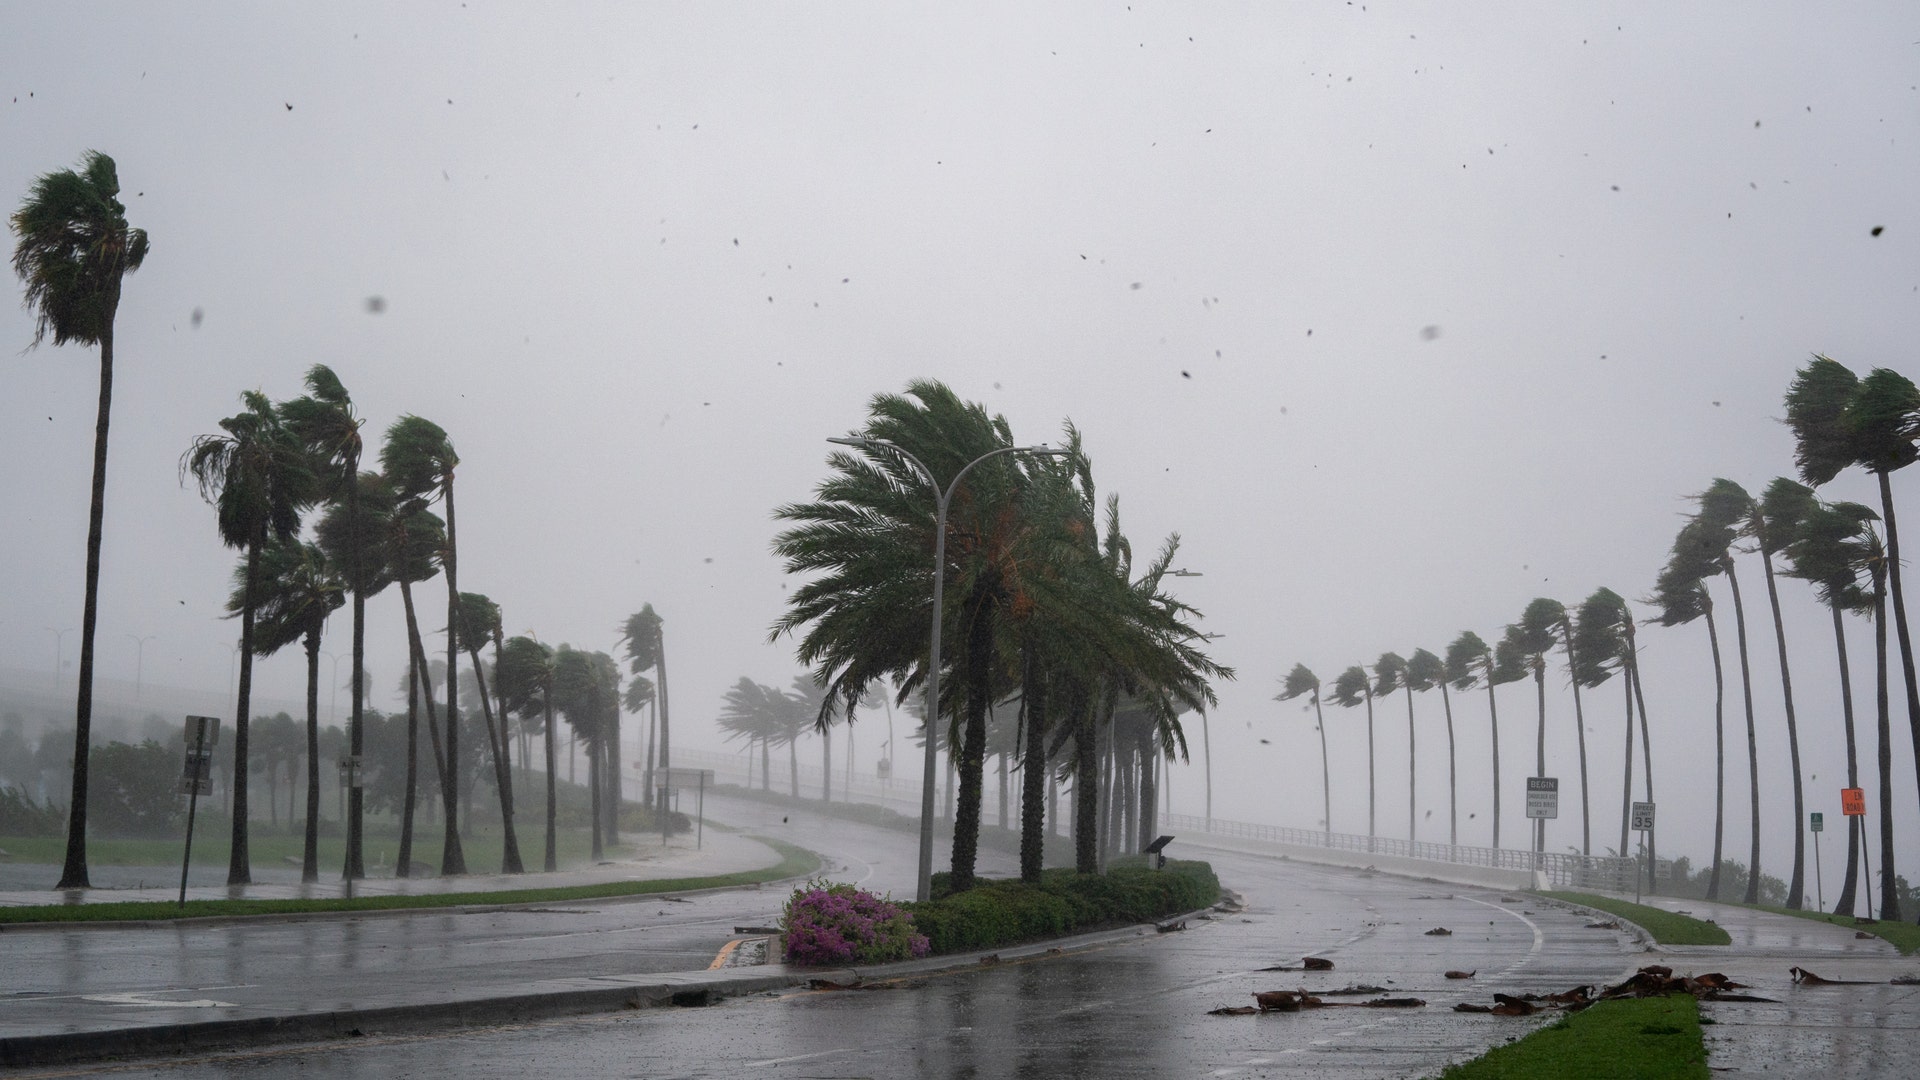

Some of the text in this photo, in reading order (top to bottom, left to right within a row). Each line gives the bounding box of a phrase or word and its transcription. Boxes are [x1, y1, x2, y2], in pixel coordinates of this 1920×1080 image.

[1530, 780, 1554, 789] BEGIN
[1846, 803, 1860, 812] ROAD
[1634, 816, 1653, 828] 35
